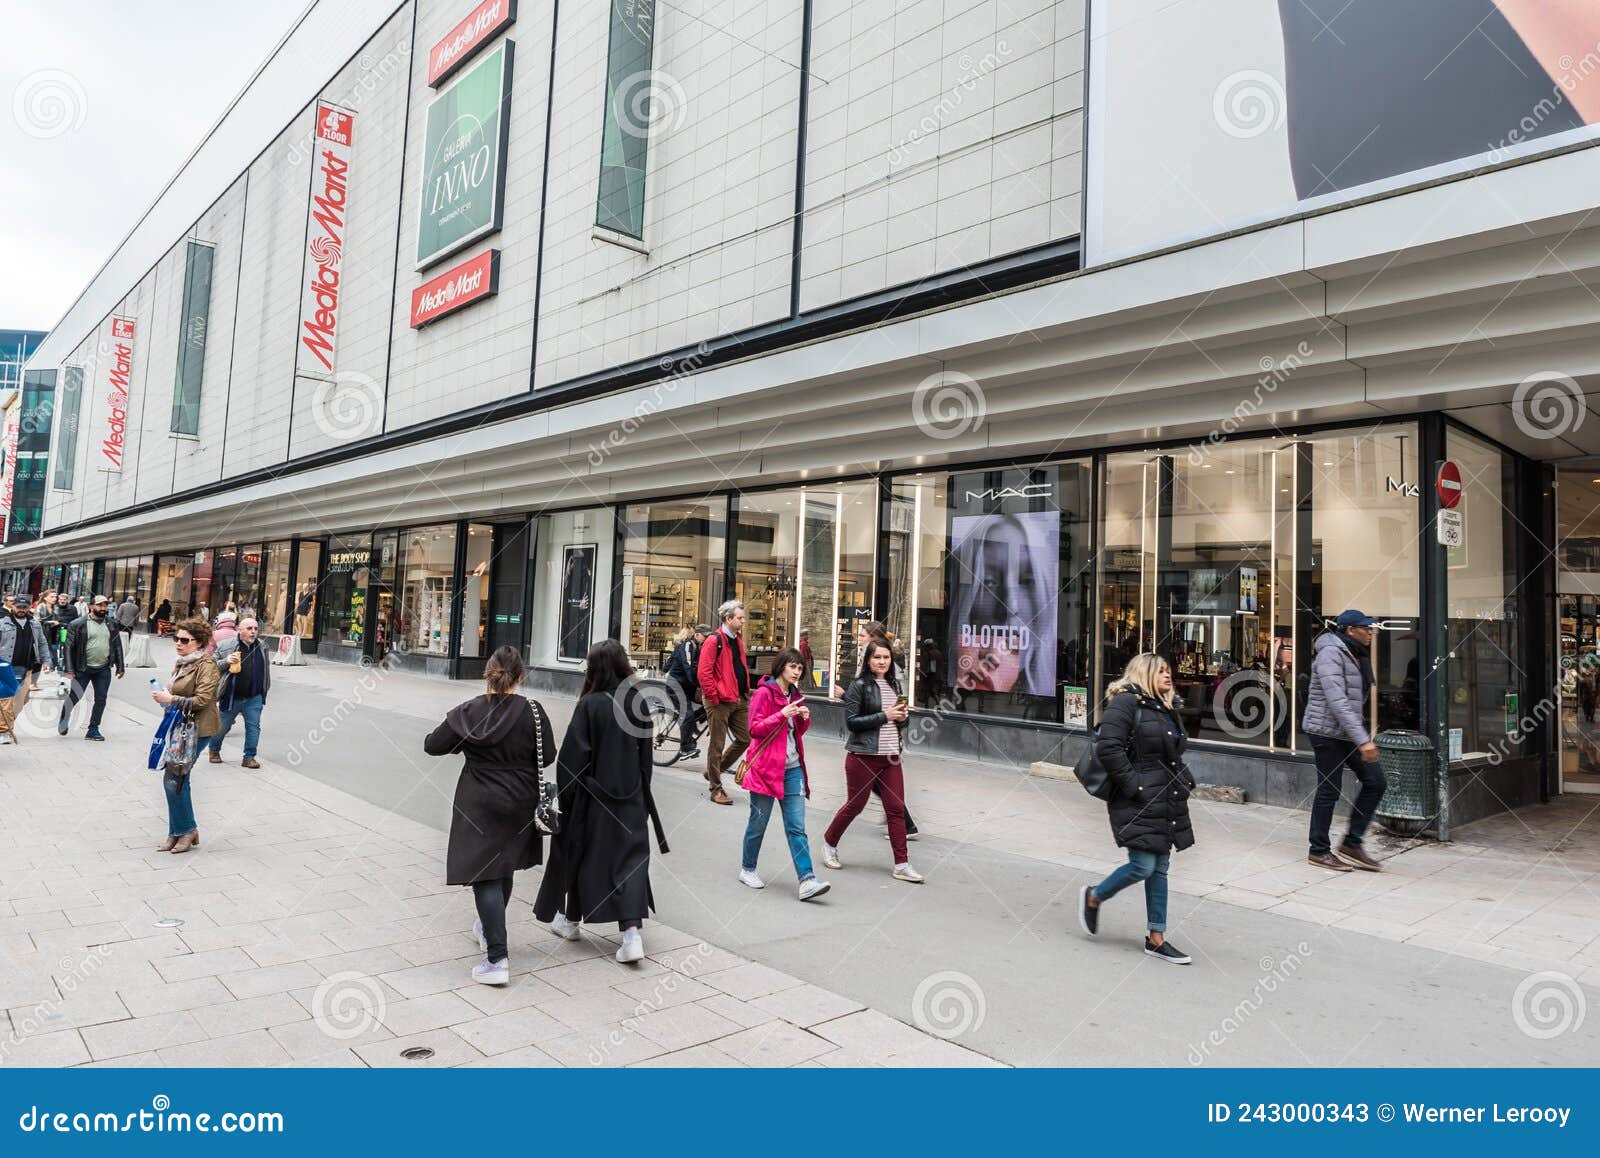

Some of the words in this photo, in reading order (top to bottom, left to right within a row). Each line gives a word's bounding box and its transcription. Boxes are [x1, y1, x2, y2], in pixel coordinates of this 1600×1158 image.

[323, 128, 347, 145] FLOOR
[431, 145, 489, 215] INNO
[966, 483, 1052, 502] MAC
[1387, 476, 1420, 497] MA
[330, 554, 340, 564] THE
[340, 553, 355, 564] BODY
[355, 552, 370, 563] SHOP
[962, 624, 1030, 650] BLOTTED
